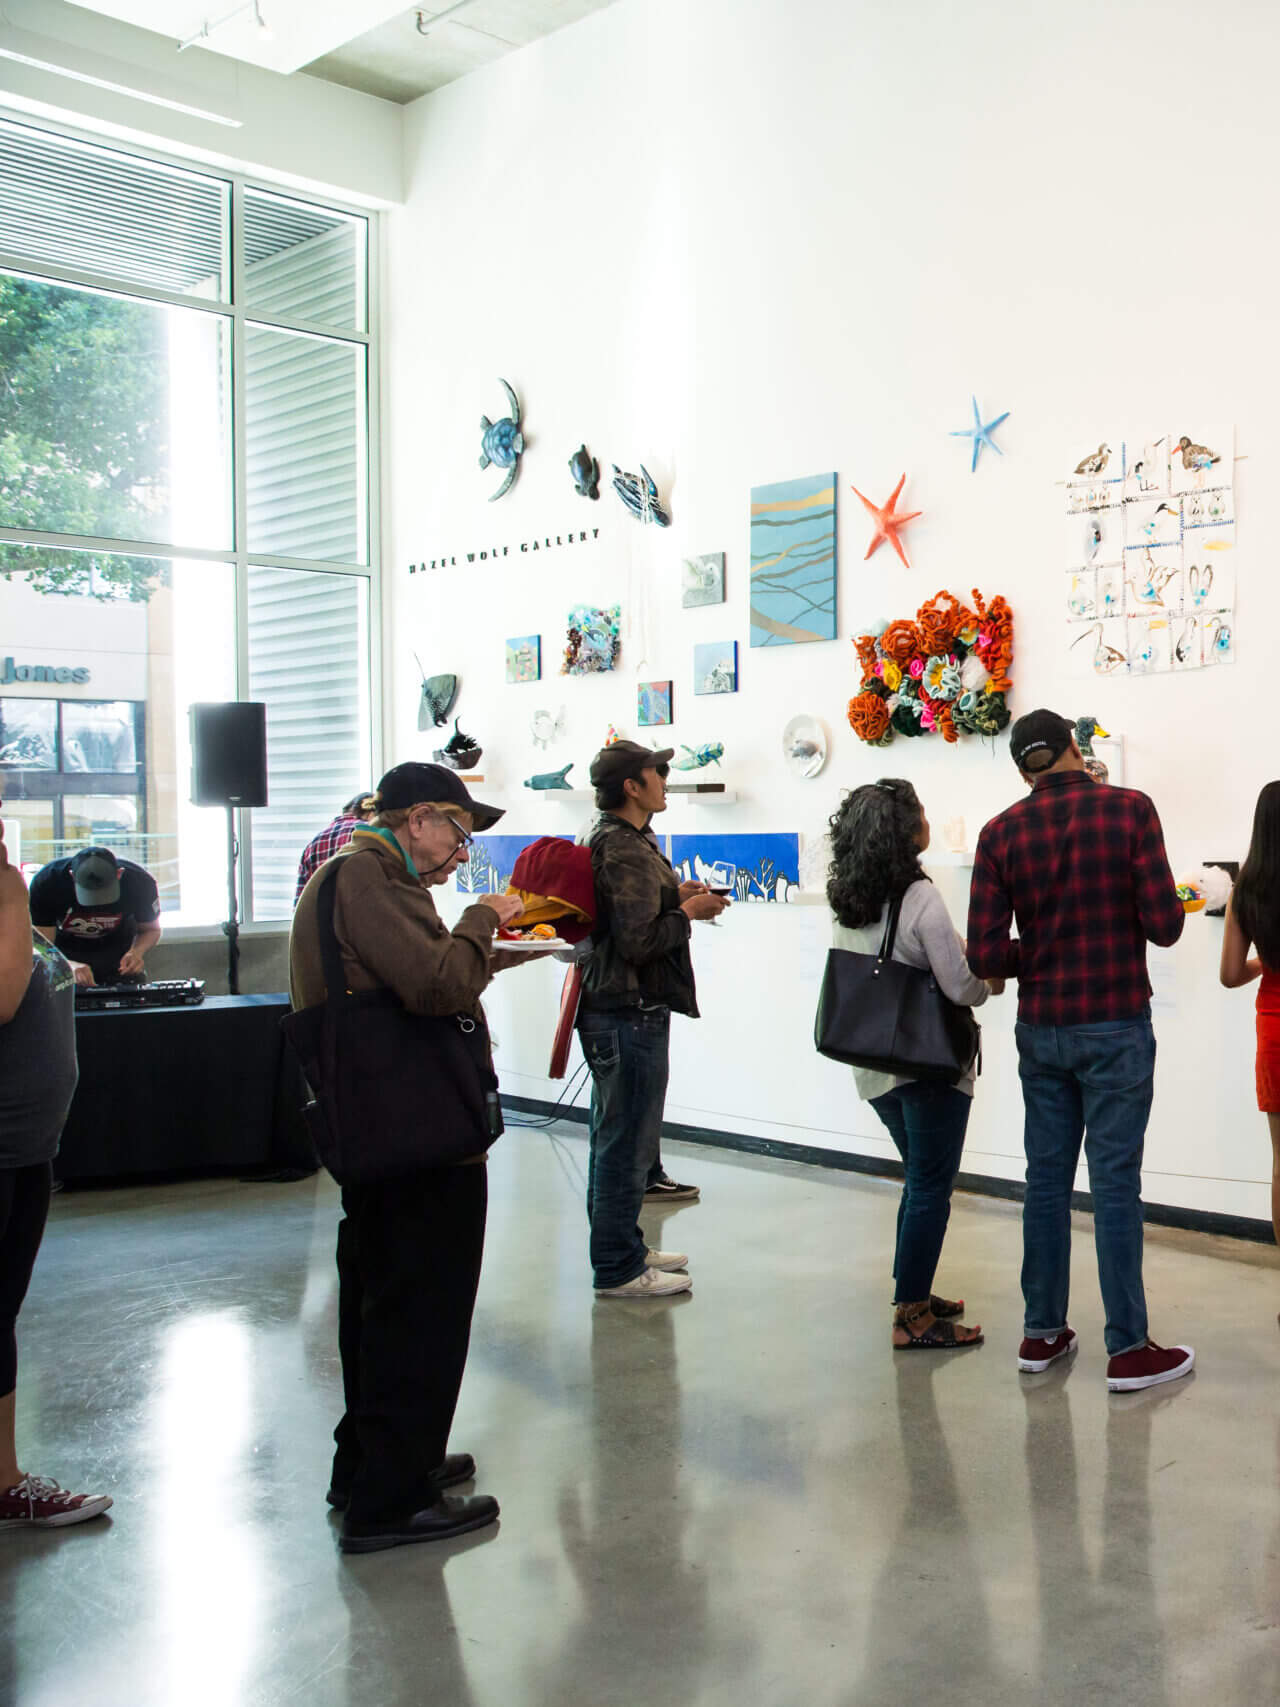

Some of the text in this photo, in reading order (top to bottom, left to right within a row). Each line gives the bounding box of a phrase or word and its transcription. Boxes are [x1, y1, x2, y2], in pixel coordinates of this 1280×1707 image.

[409, 528, 600, 574] HAZEL WOLF GALLERY
[0, 656, 91, 685] Jones
